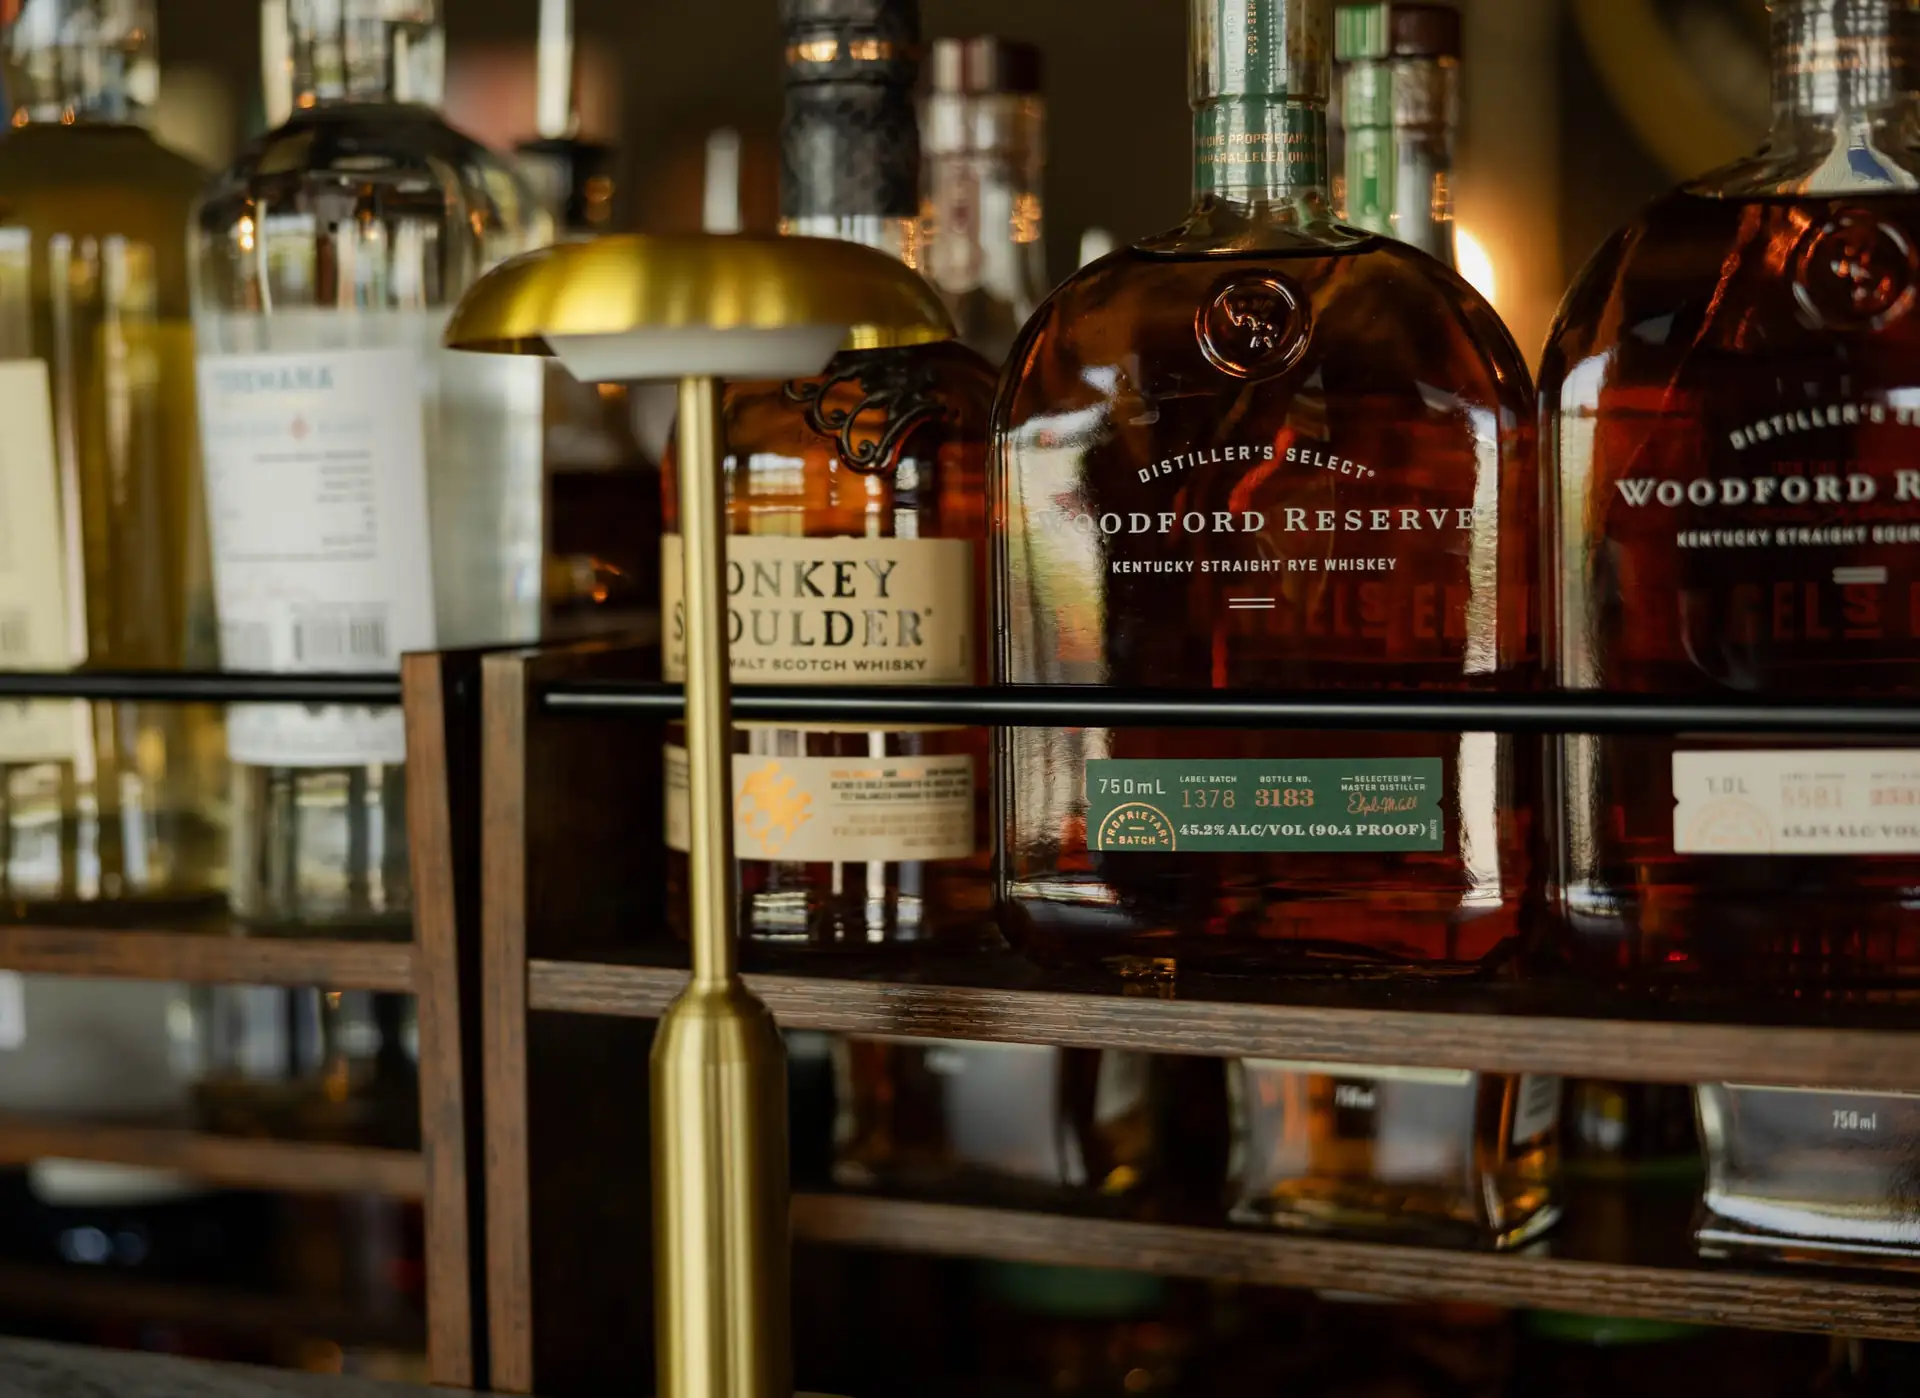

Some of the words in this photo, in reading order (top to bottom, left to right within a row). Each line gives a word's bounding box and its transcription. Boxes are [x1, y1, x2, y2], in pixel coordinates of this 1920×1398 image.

[1729, 403, 1886, 451] DISTILLER'S
[1137, 444, 1274, 484] DISTILLER'S
[1614, 472, 1879, 507] WOODFORD
[1072, 510, 1267, 535] OODFORD
[1677, 528, 1772, 549] KENTUCKY
[1775, 525, 1867, 547] STRAIGHT
[1112, 560, 1195, 574] KENTUCKY
[1200, 559, 1281, 573] STRAIGHT
[1288, 558, 1318, 572] RYE
[1324, 557, 1397, 572] WHISKEY
[726, 559, 898, 599] ONKEY
[771, 658, 847, 671] SCOTCH
[852, 658, 927, 672] WHISKY
[1098, 778, 1166, 795] 750mL
[1179, 775, 1207, 783] LABEL
[1209, 775, 1238, 783] BATCH
[1259, 775, 1293, 783] BOTTLE
[1295, 775, 1312, 783] NO.
[1340, 783, 1377, 792] MASTER
[1379, 783, 1426, 791] DISTILLER
[1354, 775, 1399, 783] SELECTED
[1401, 775, 1412, 783] BY
[1181, 789, 1236, 809] 1378
[1255, 788, 1315, 807] 3183
[1105, 810, 1169, 845] PROPRIETARY
[1309, 823, 1353, 837] (90.4
[1355, 822, 1427, 838] PROOF)
[1118, 836, 1157, 845] BATCH
[1831, 1109, 1877, 1131] 750ml
